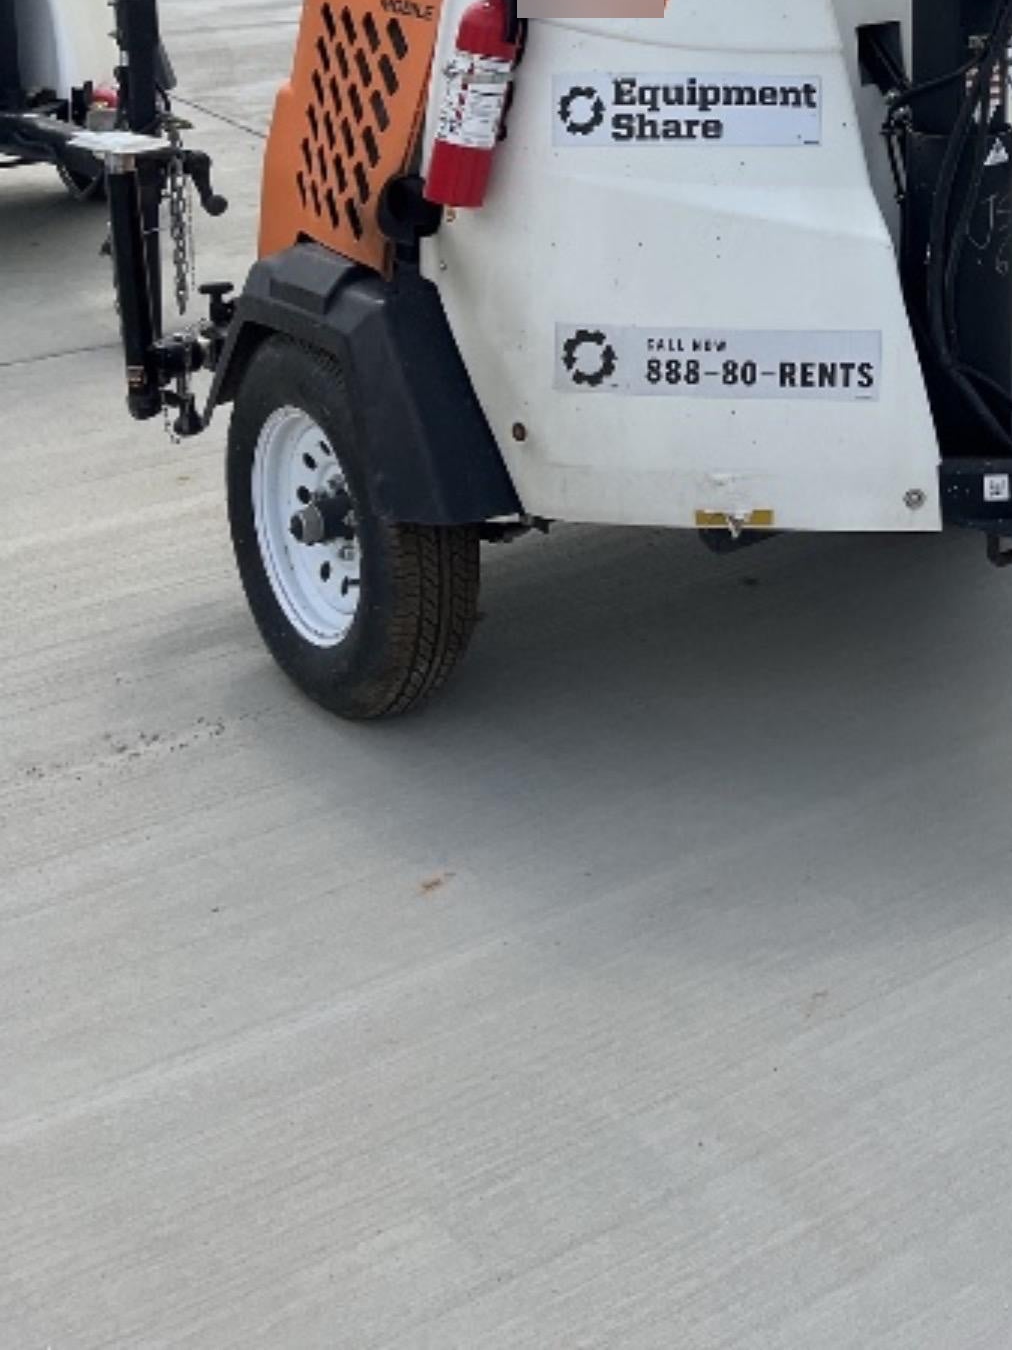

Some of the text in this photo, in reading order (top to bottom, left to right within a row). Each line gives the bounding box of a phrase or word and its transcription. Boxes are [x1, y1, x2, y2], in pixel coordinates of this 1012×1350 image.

[612, 76, 818, 112] Equipment
[611, 113, 724, 142] Share
[645, 358, 875, 389] 888-80-RENTS
